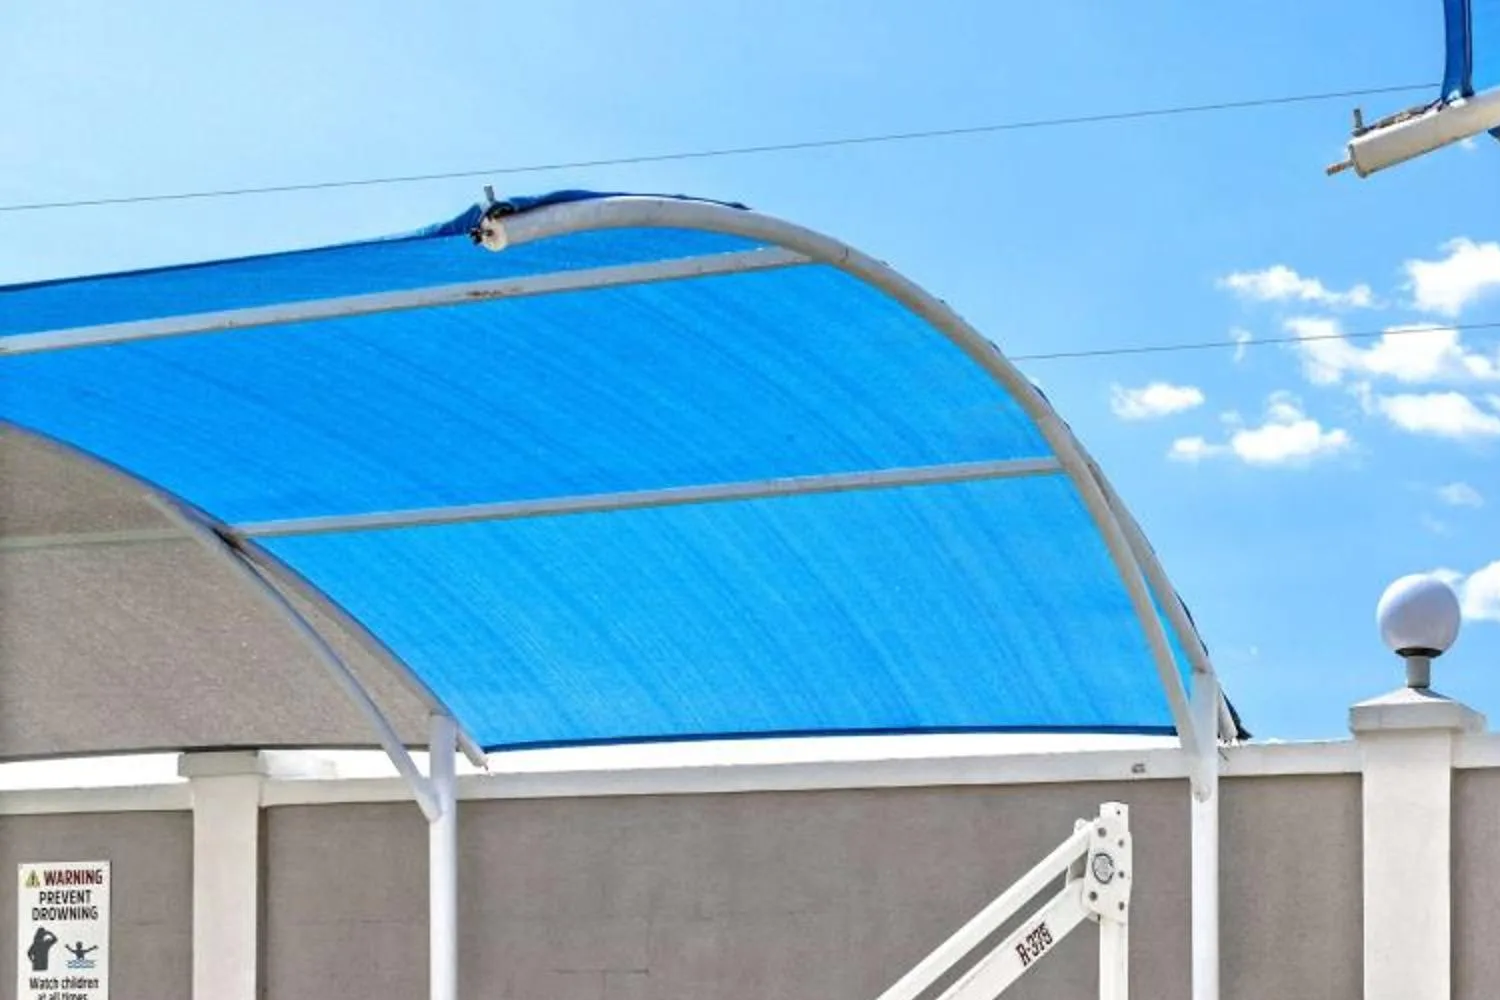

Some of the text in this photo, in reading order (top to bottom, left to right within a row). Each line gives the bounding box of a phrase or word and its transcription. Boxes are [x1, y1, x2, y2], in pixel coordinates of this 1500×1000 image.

[44, 869, 103, 886] WARNING
[39, 889, 92, 905] PREVENT
[32, 905, 99, 921] DROWNING
[29, 975, 99, 990] Watch children
